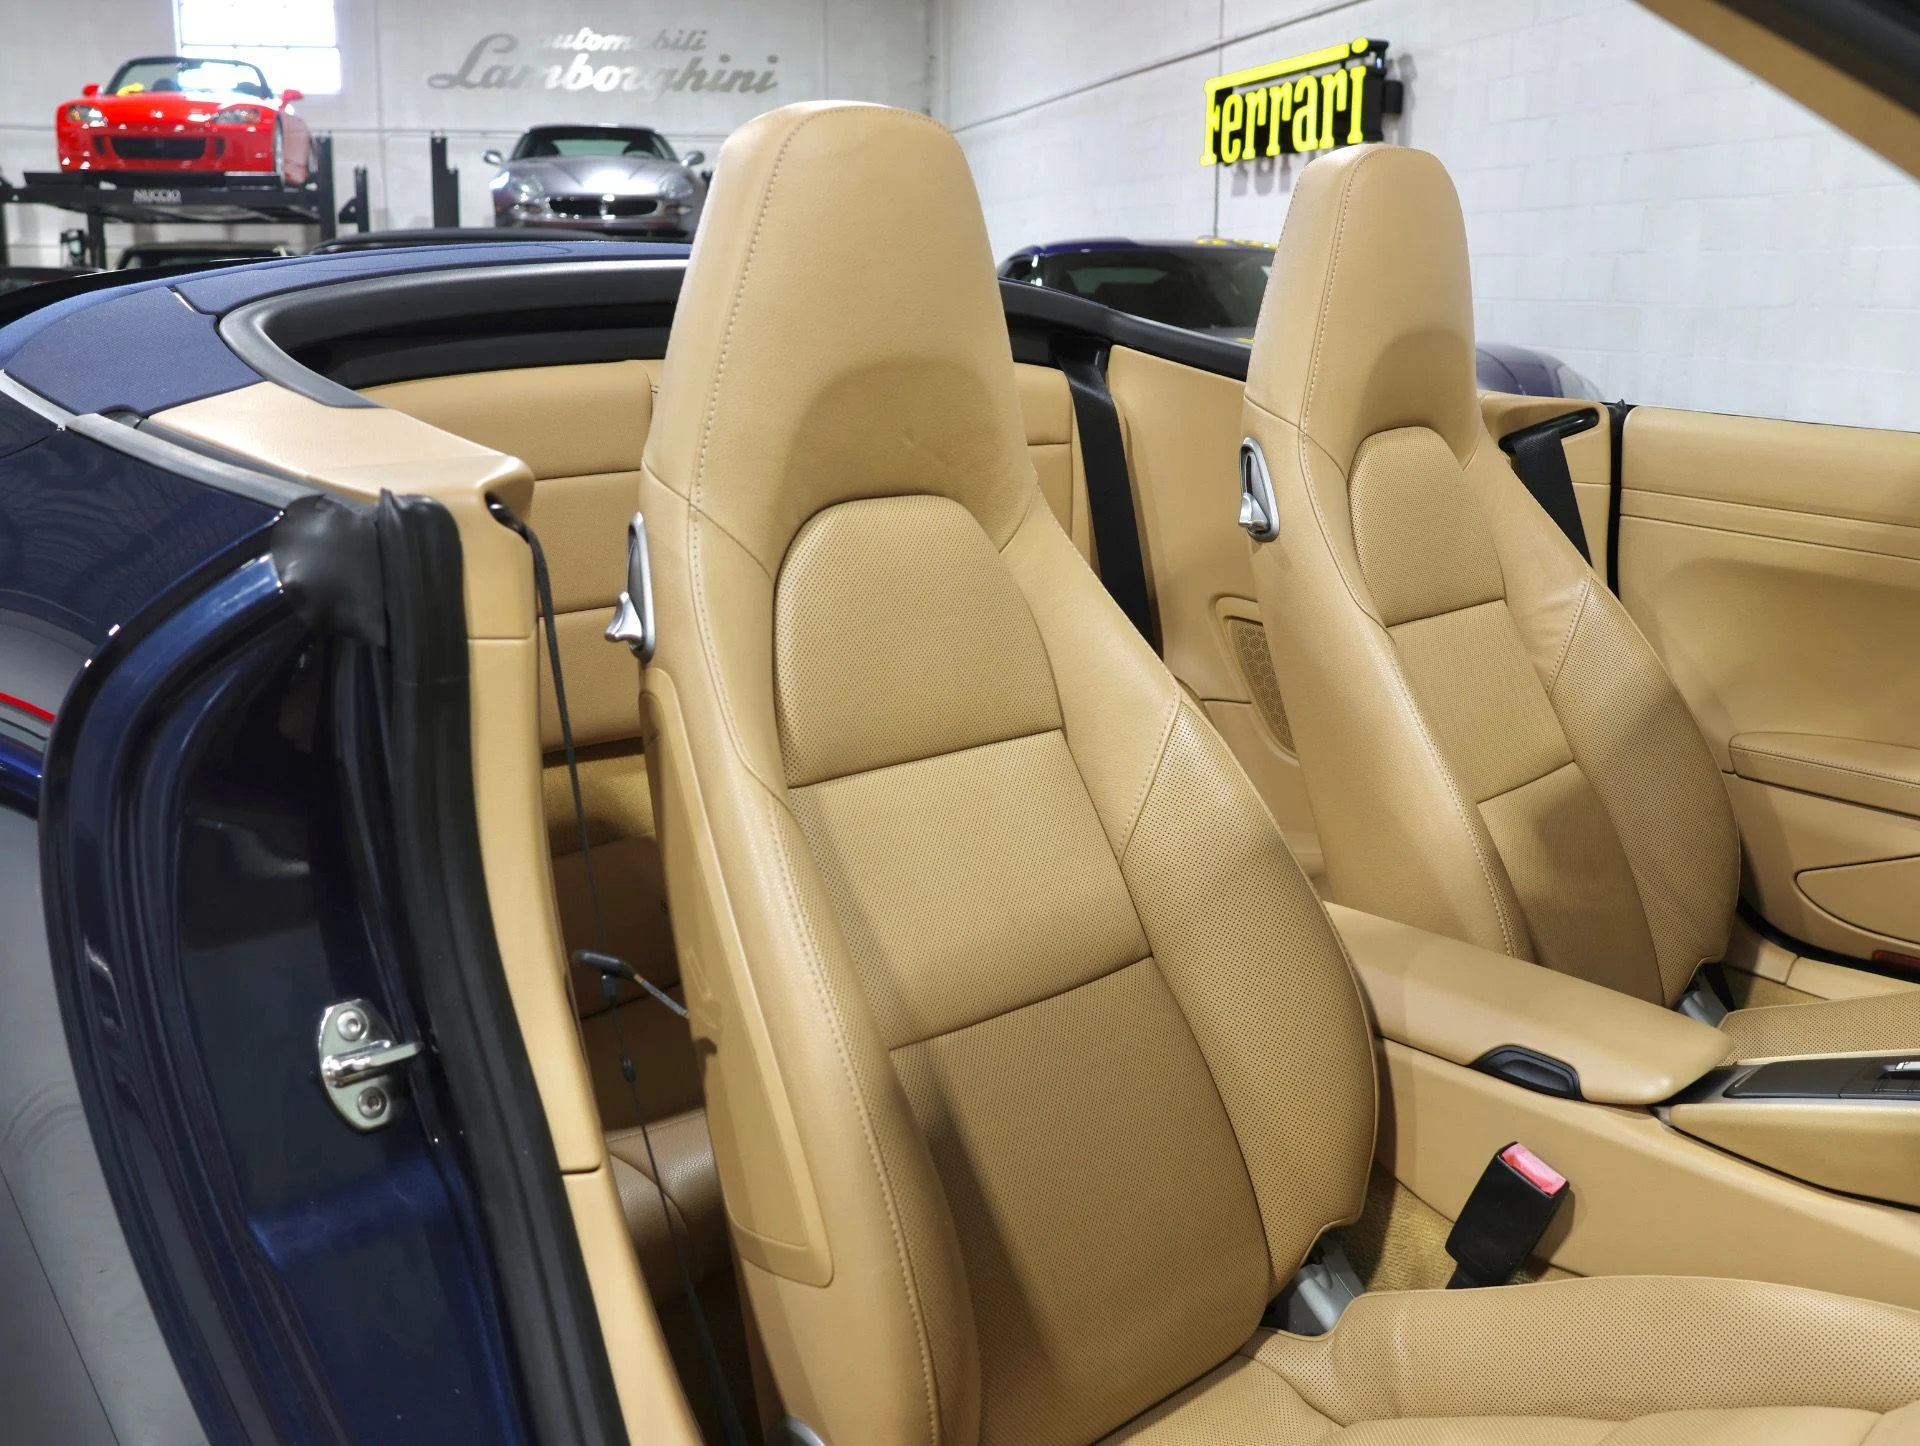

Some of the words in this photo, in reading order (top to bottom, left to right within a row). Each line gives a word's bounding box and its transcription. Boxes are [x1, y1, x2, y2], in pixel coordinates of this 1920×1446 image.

[427, 33, 779, 99] Lamborghini
[539, 27, 708, 51] autombili
[1200, 37, 1369, 166] Ferrari
